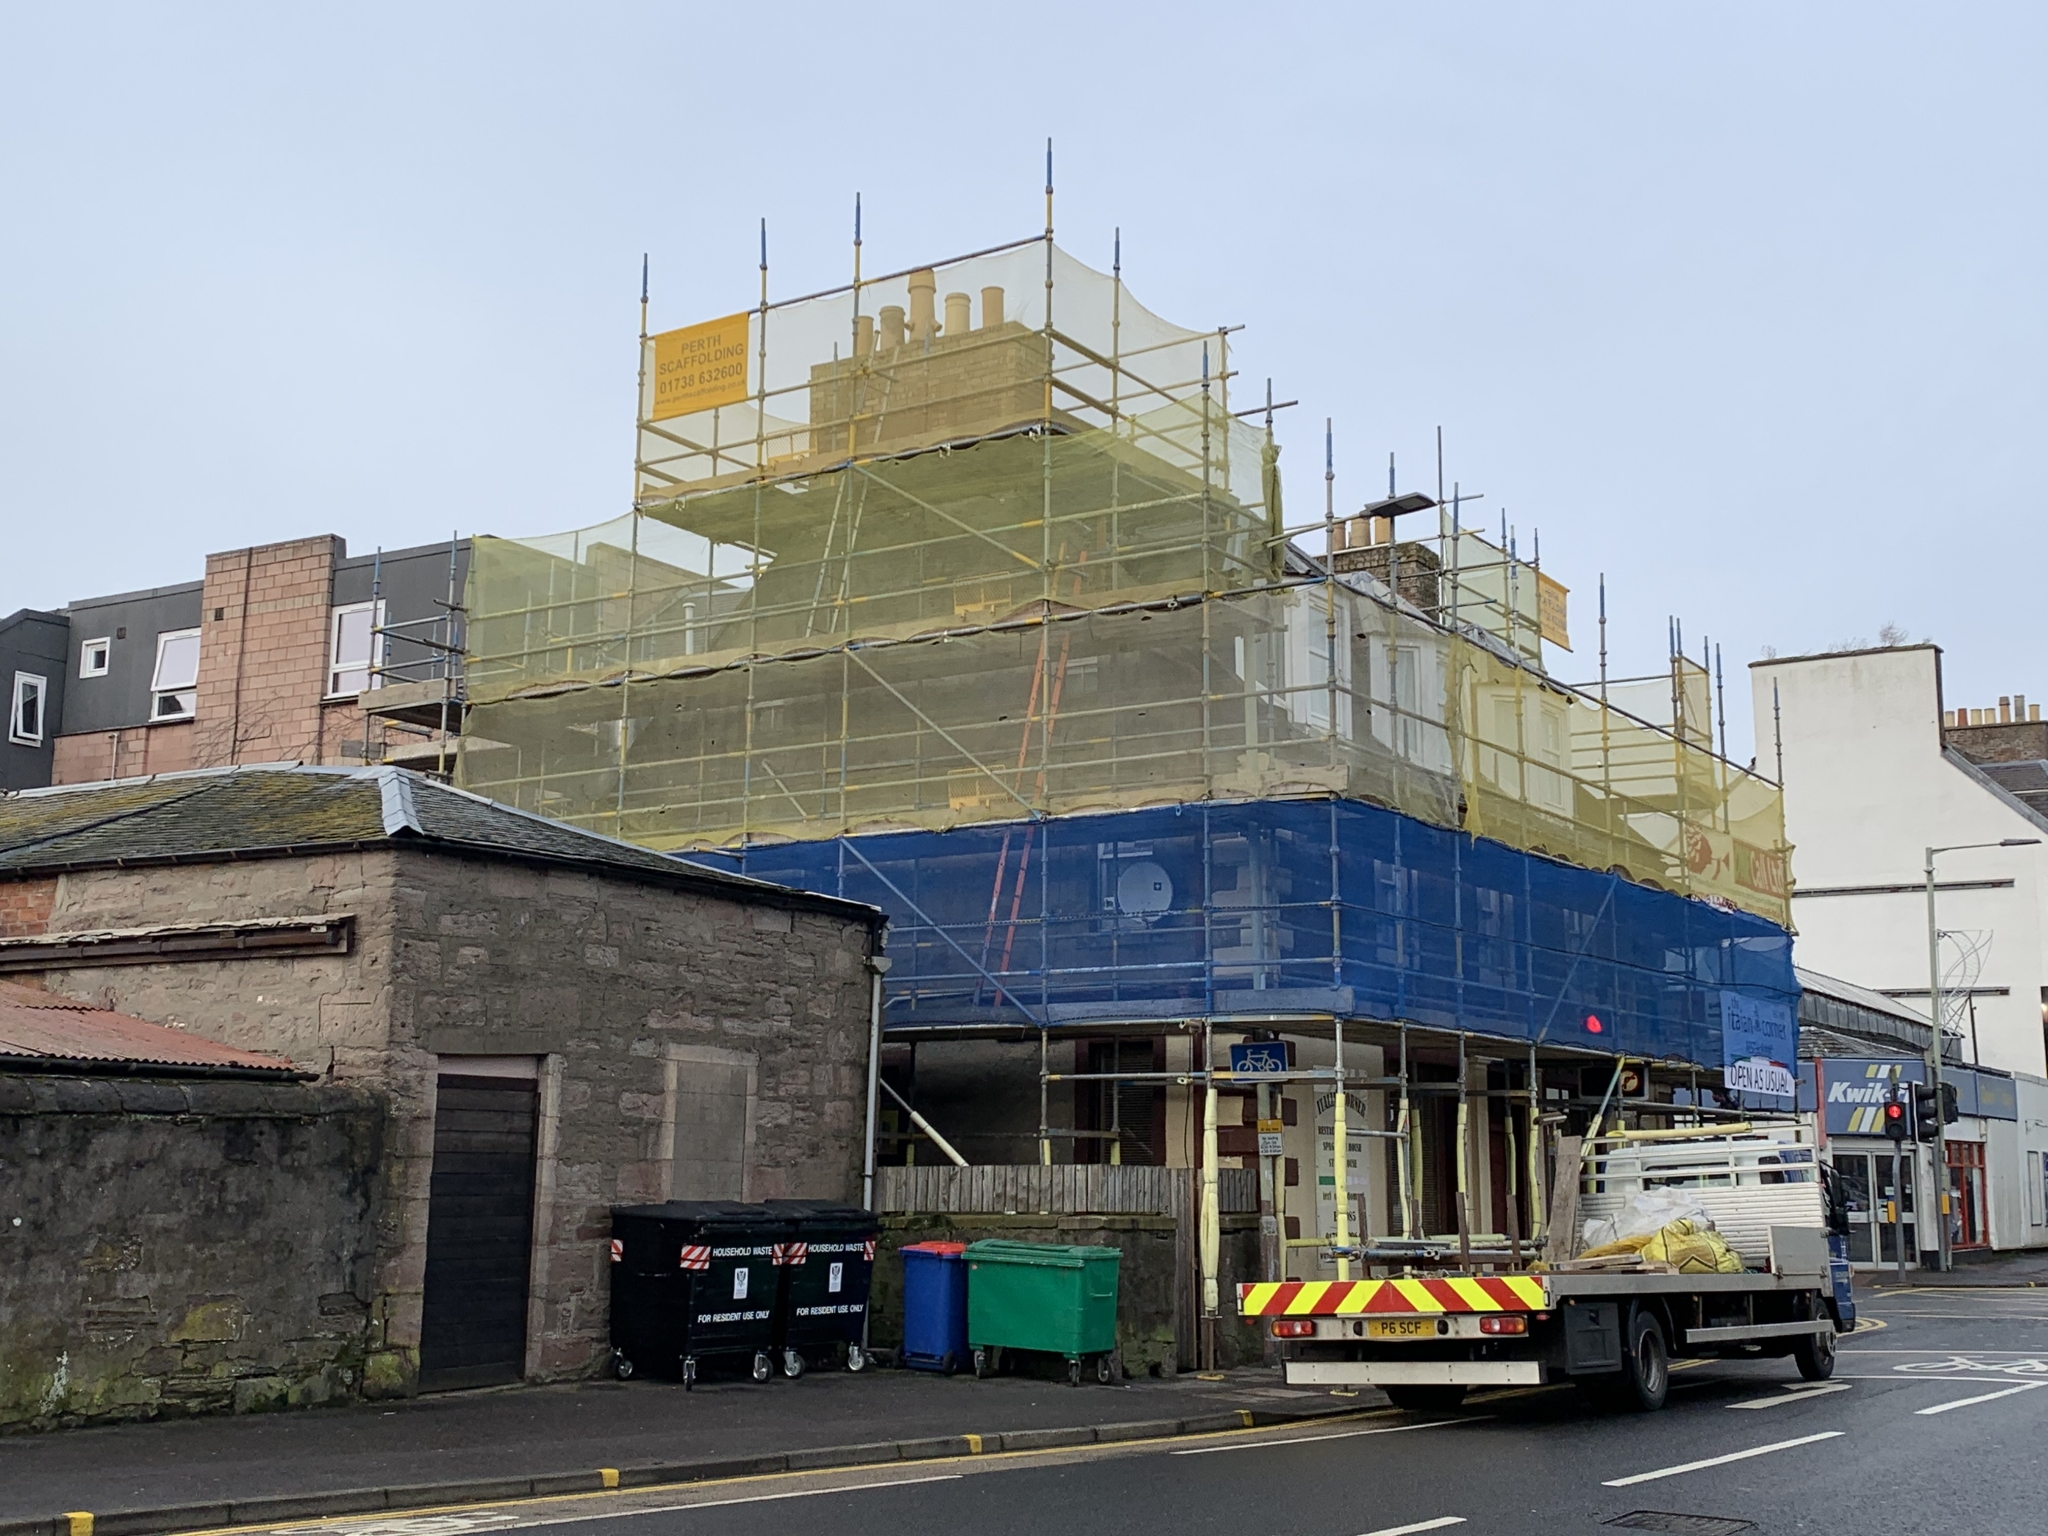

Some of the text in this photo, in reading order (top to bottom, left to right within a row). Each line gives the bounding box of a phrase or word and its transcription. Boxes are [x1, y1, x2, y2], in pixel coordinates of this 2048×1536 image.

[681, 334, 721, 354] PERTH
[658, 343, 744, 375] SCAFFOLDING
[659, 362, 743, 394] 01738 632600
[1730, 1064, 1789, 1093] OPEN AS USUAL
[712, 1246, 773, 1257] HOUSEHOLD WASTE
[808, 1243, 864, 1253] HOUSEHOLD WASTE
[697, 1310, 770, 1323] FOR RESIDENT USE ONLY
[796, 1304, 864, 1316] FOR RESIDENT USE ONLY
[1381, 1321, 1421, 1334] P6 SCF
